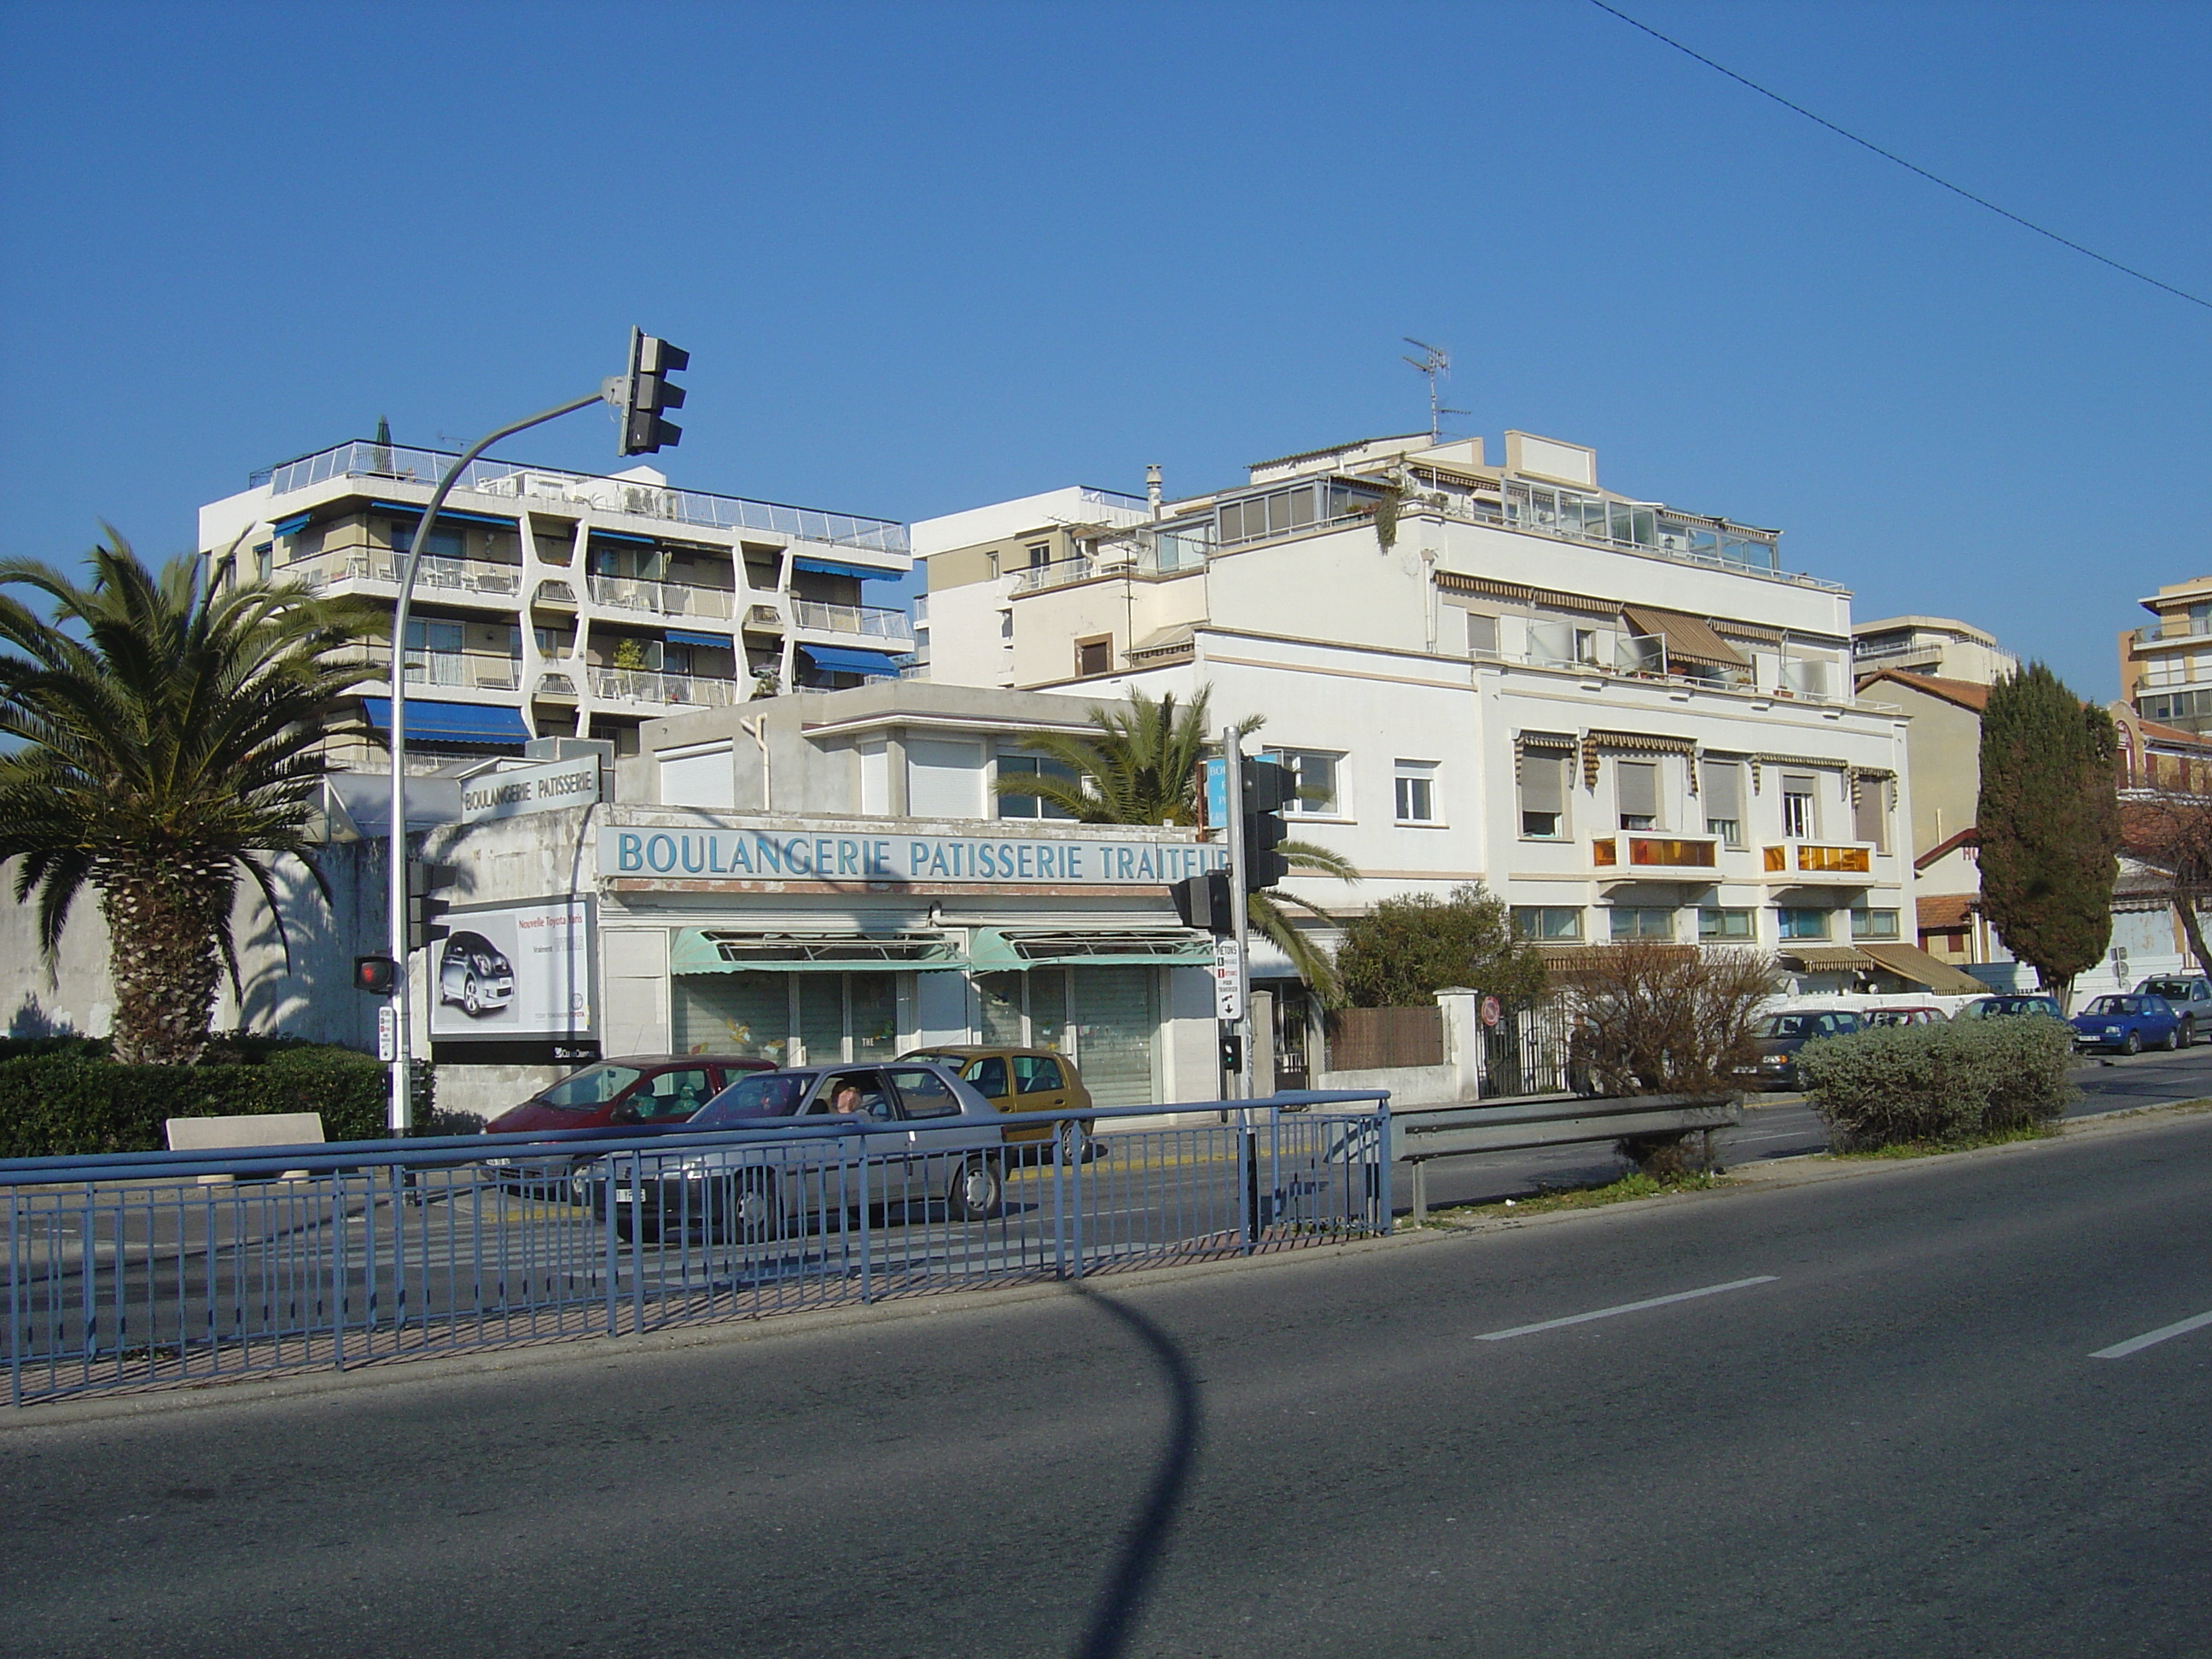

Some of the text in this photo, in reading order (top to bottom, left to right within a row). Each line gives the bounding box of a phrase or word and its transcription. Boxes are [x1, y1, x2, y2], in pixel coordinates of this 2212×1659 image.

[465, 771, 592, 811] BOULANGERIE PATISSERIE
[619, 833, 891, 876] BOULANGERIE
[910, 841, 1083, 878] PATISSERIE
[519, 914, 583, 928] Nouvelle Toyota Yaris
